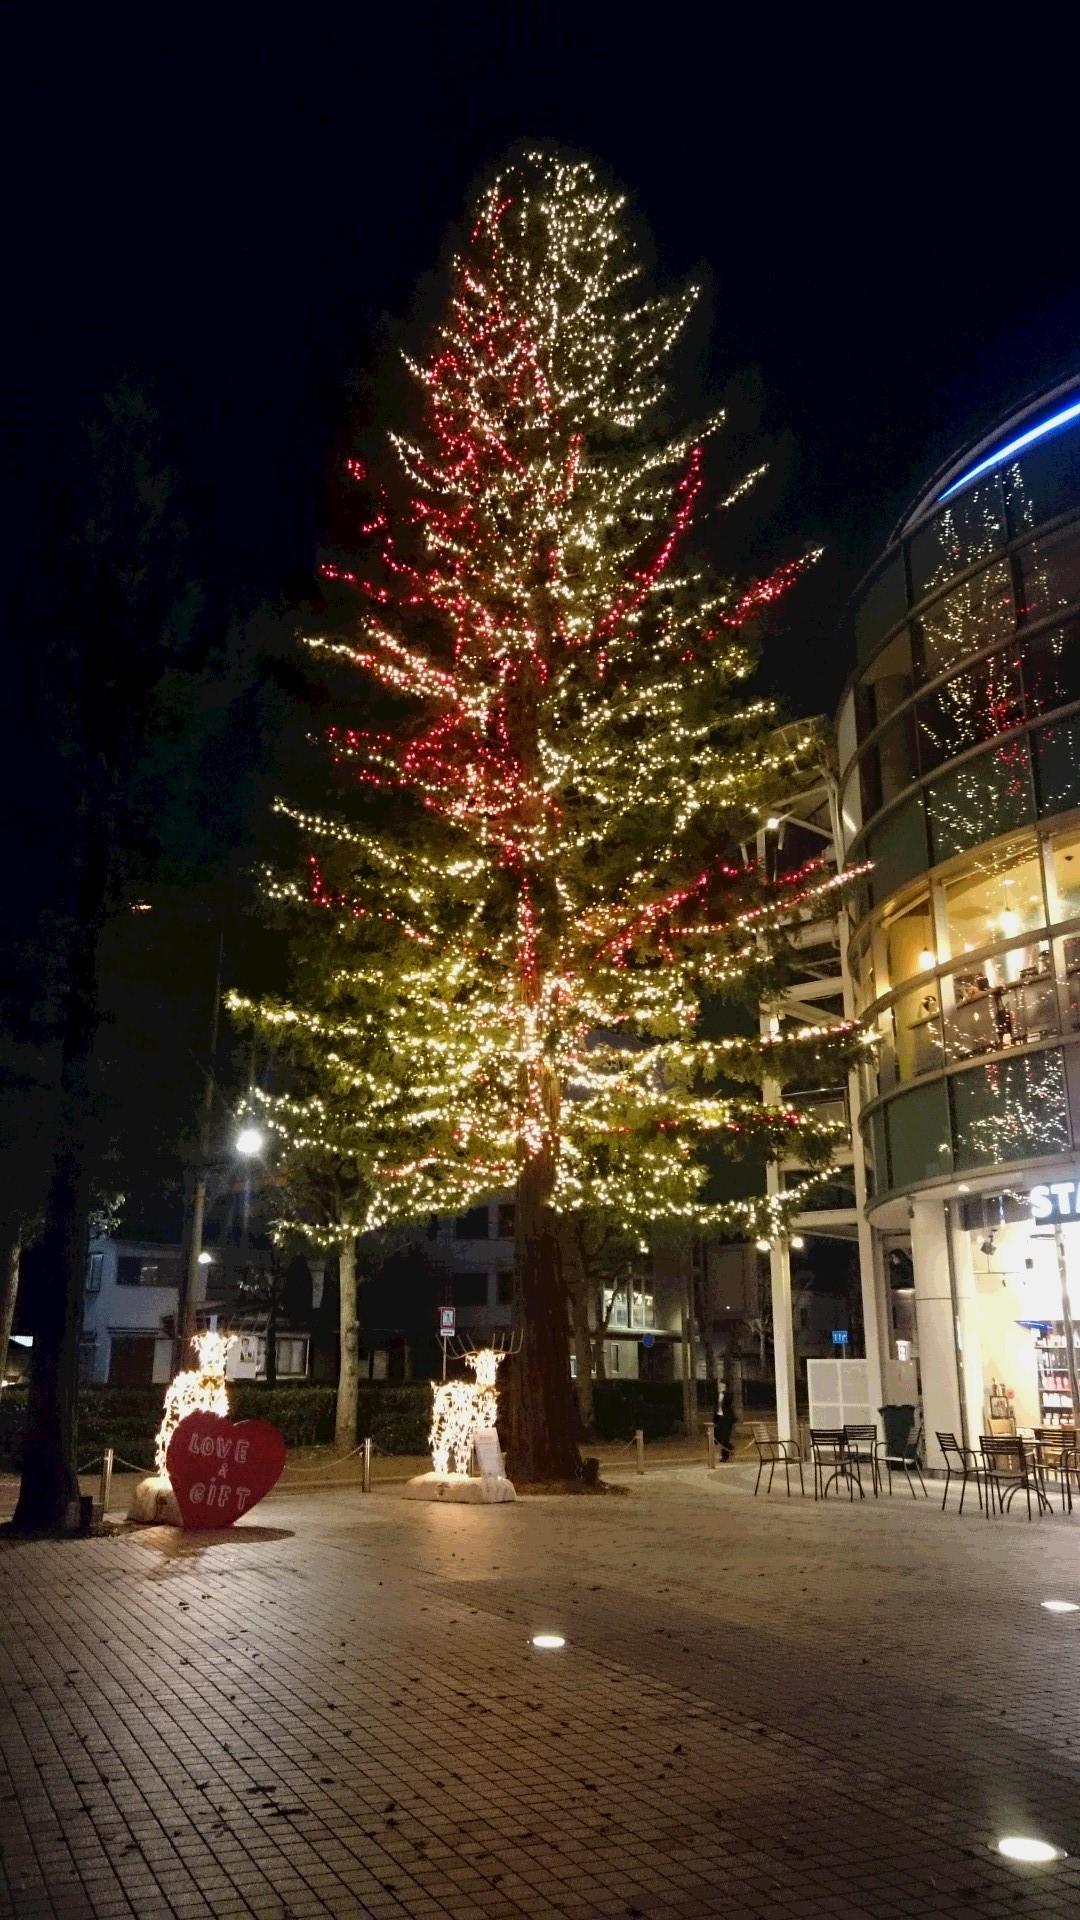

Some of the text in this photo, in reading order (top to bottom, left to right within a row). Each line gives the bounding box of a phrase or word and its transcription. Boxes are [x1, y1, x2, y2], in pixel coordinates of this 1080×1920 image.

[1029, 1181, 1080, 1218] ST
[188, 1433, 250, 1464] LOVE
[218, 1463, 228, 1479] &
